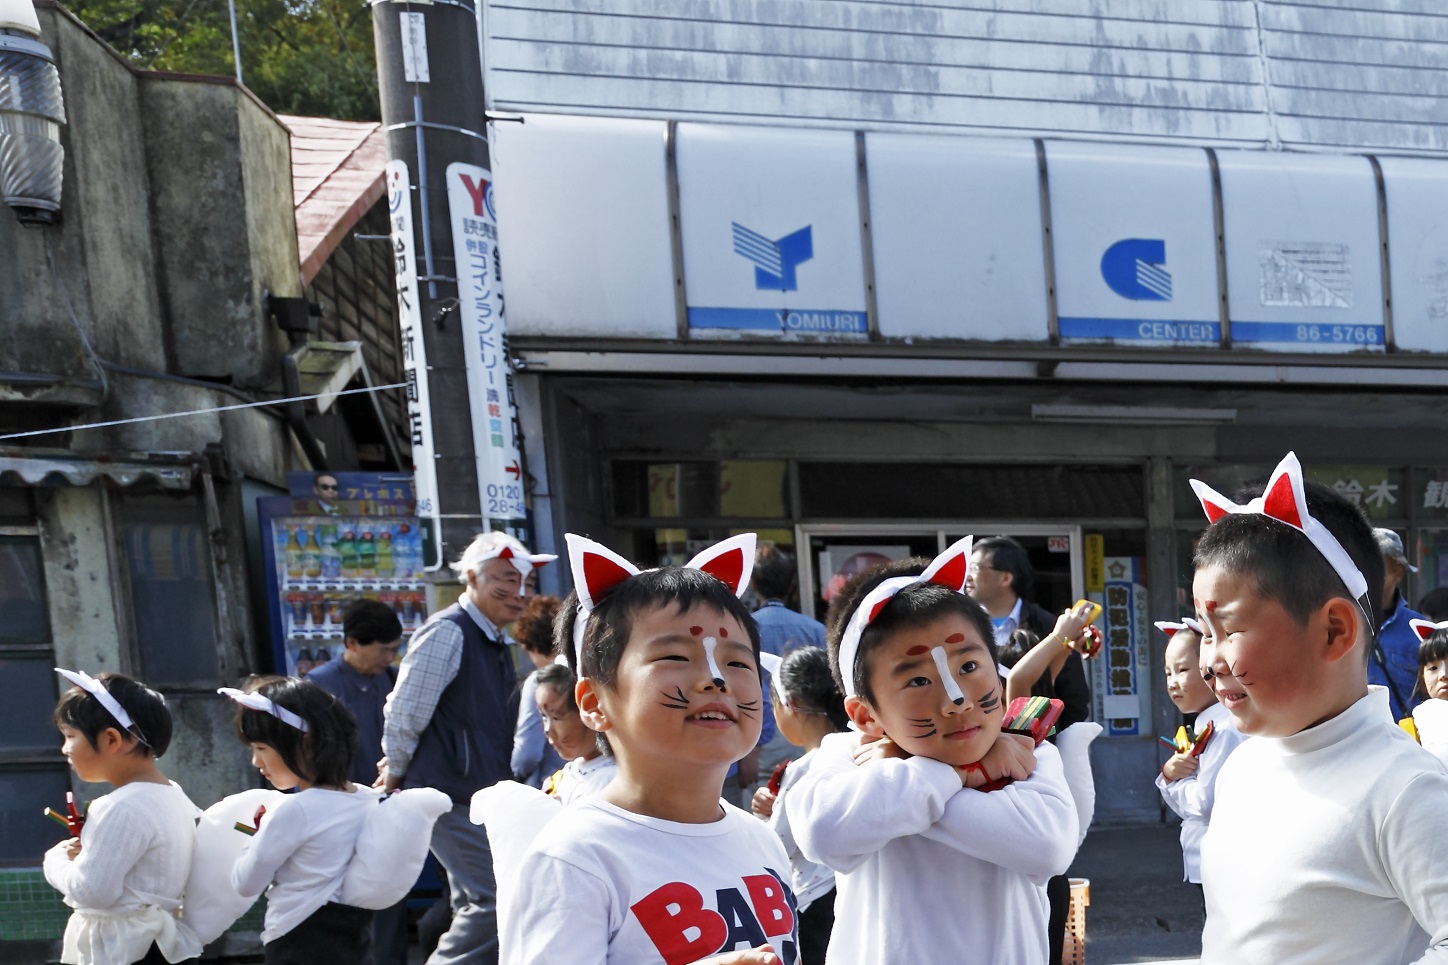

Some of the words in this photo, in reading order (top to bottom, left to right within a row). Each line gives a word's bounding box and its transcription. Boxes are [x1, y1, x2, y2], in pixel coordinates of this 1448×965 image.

[470, 253, 498, 385] コインランドリー
[776, 312, 860, 331] YOMIURI
[1138, 322, 1214, 341] CENTER
[1296, 324, 1378, 342] 86-5766
[486, 483, 520, 500] 0120
